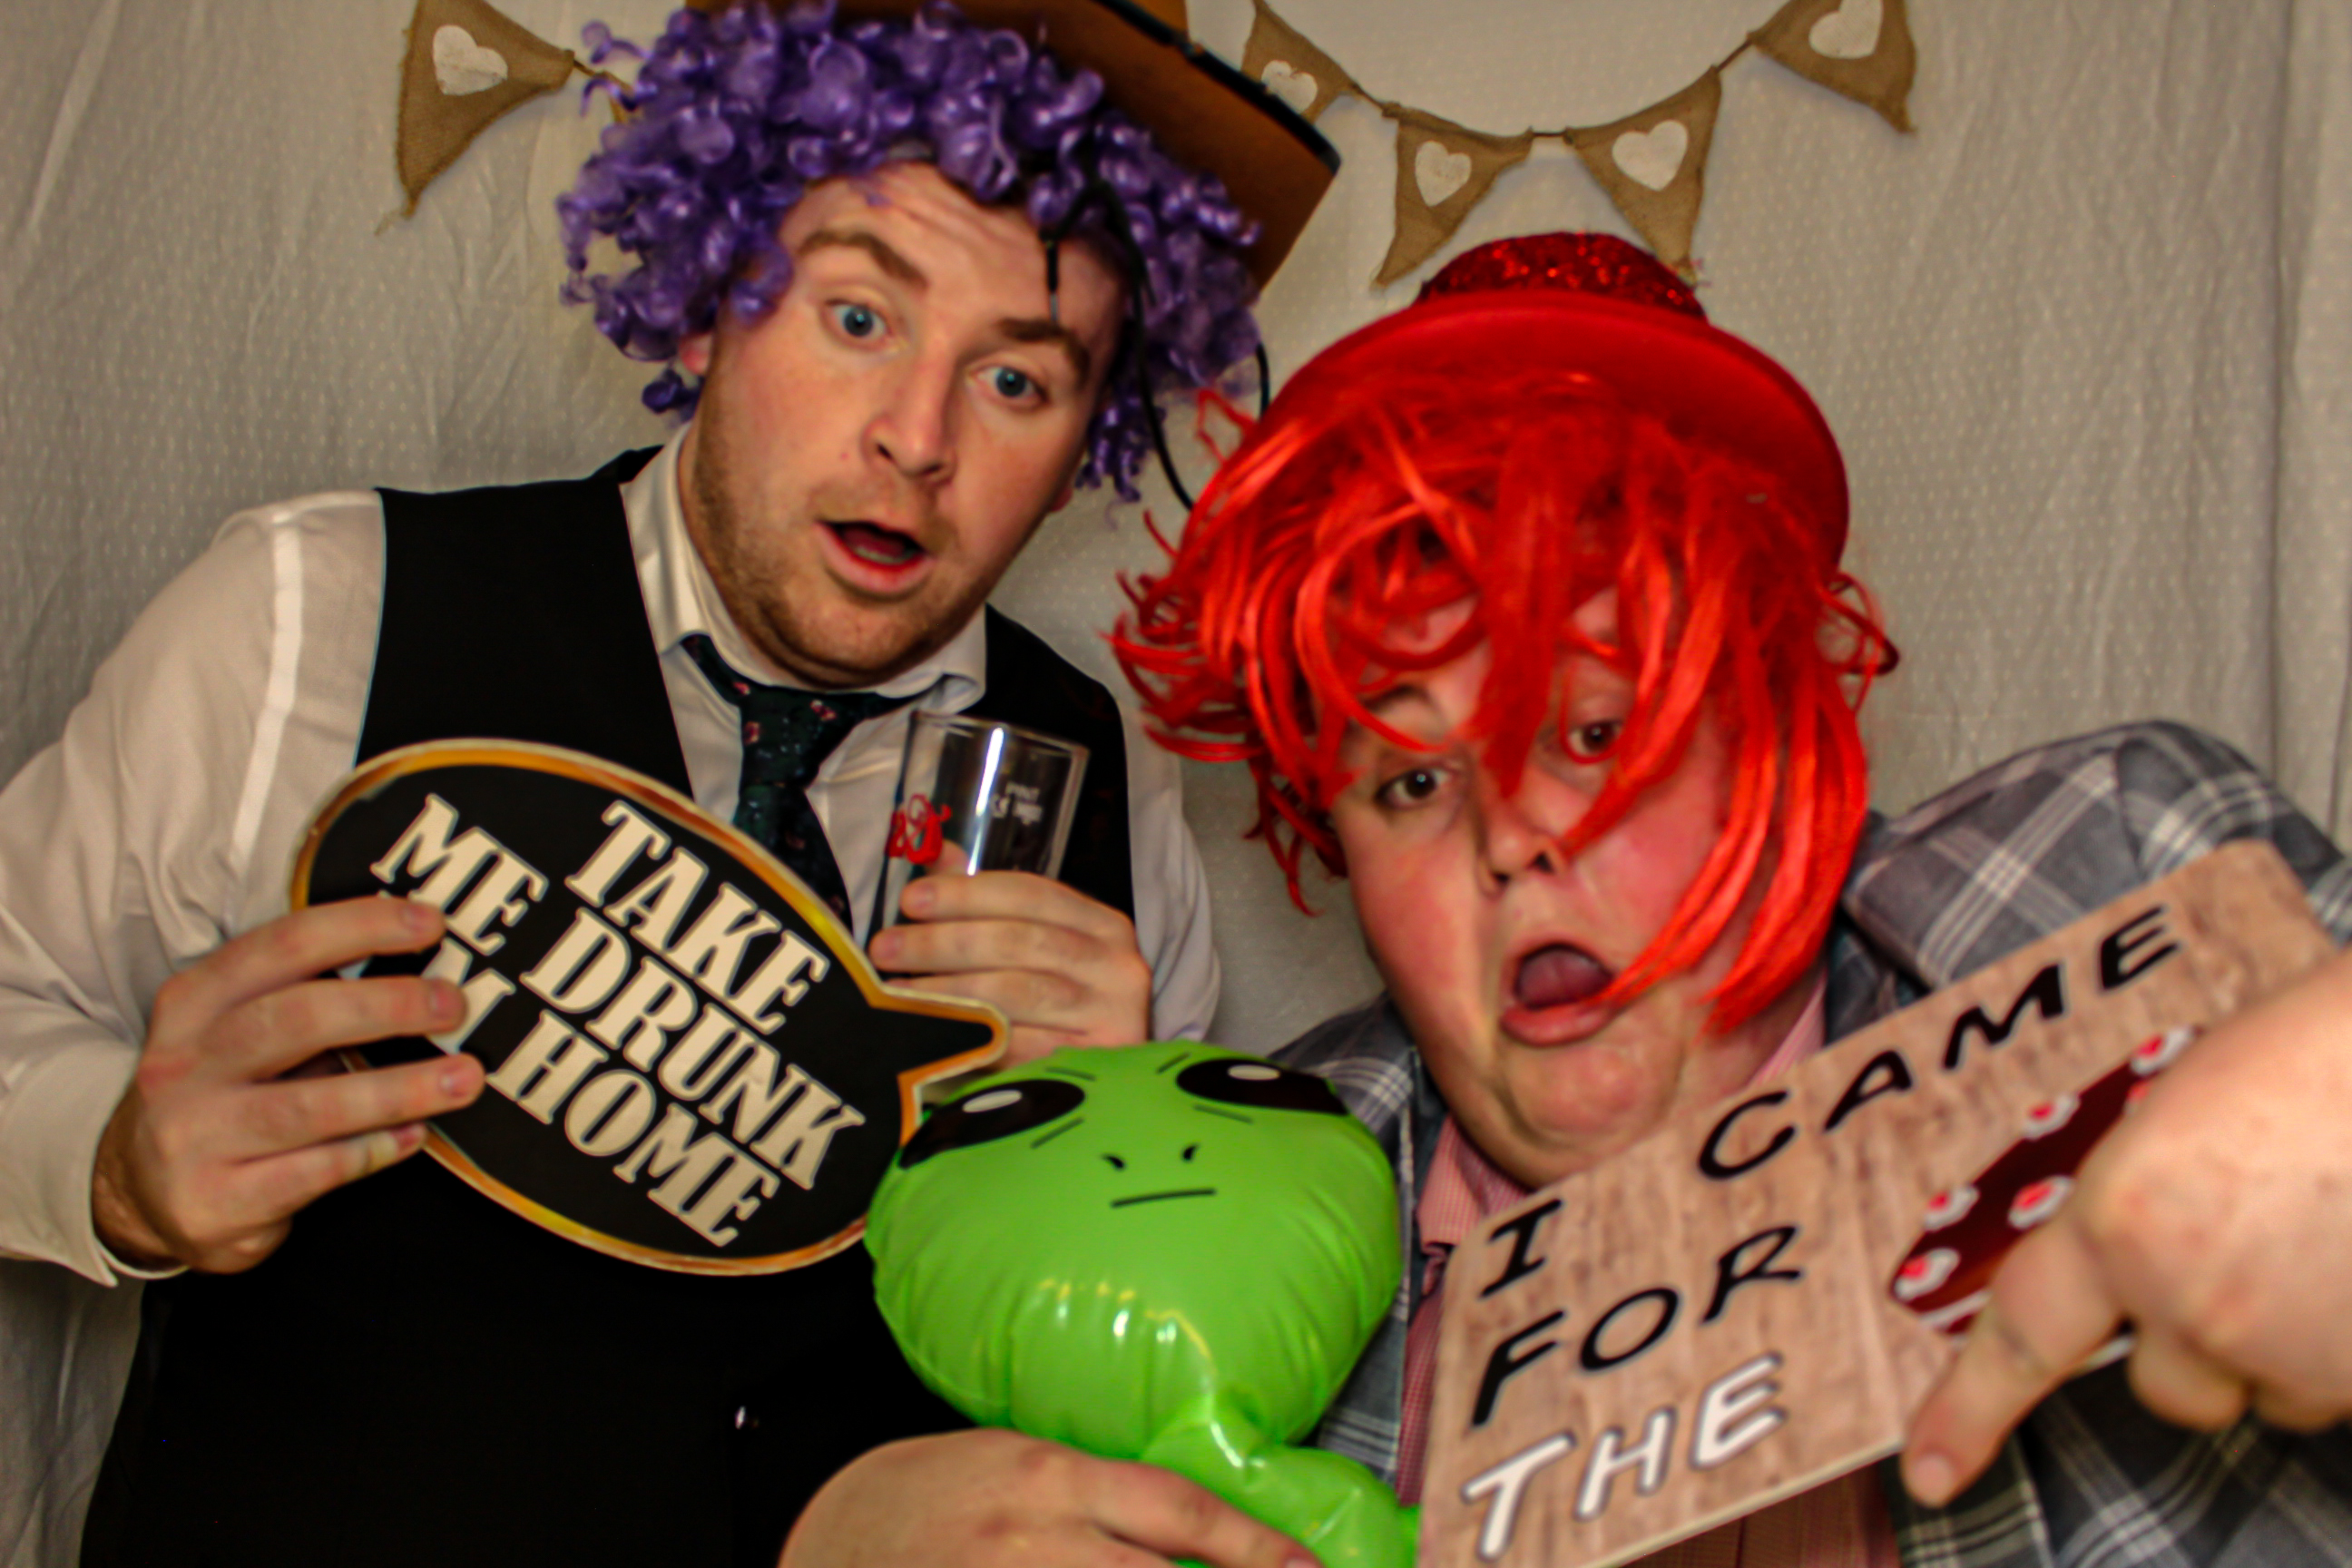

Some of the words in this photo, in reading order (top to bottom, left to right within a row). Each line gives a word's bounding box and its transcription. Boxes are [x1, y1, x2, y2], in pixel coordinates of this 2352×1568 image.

[370, 794, 547, 955] ME
[520, 907, 865, 1190] DRUNK
[565, 800, 829, 1033] TAKE
[486, 1010, 780, 1248] HOME
[1481, 1199, 1563, 1298] I
[1698, 905, 2180, 1181] CAME
[1471, 1226, 1802, 1427] FOR
[1460, 1355, 1788, 1561] THE
